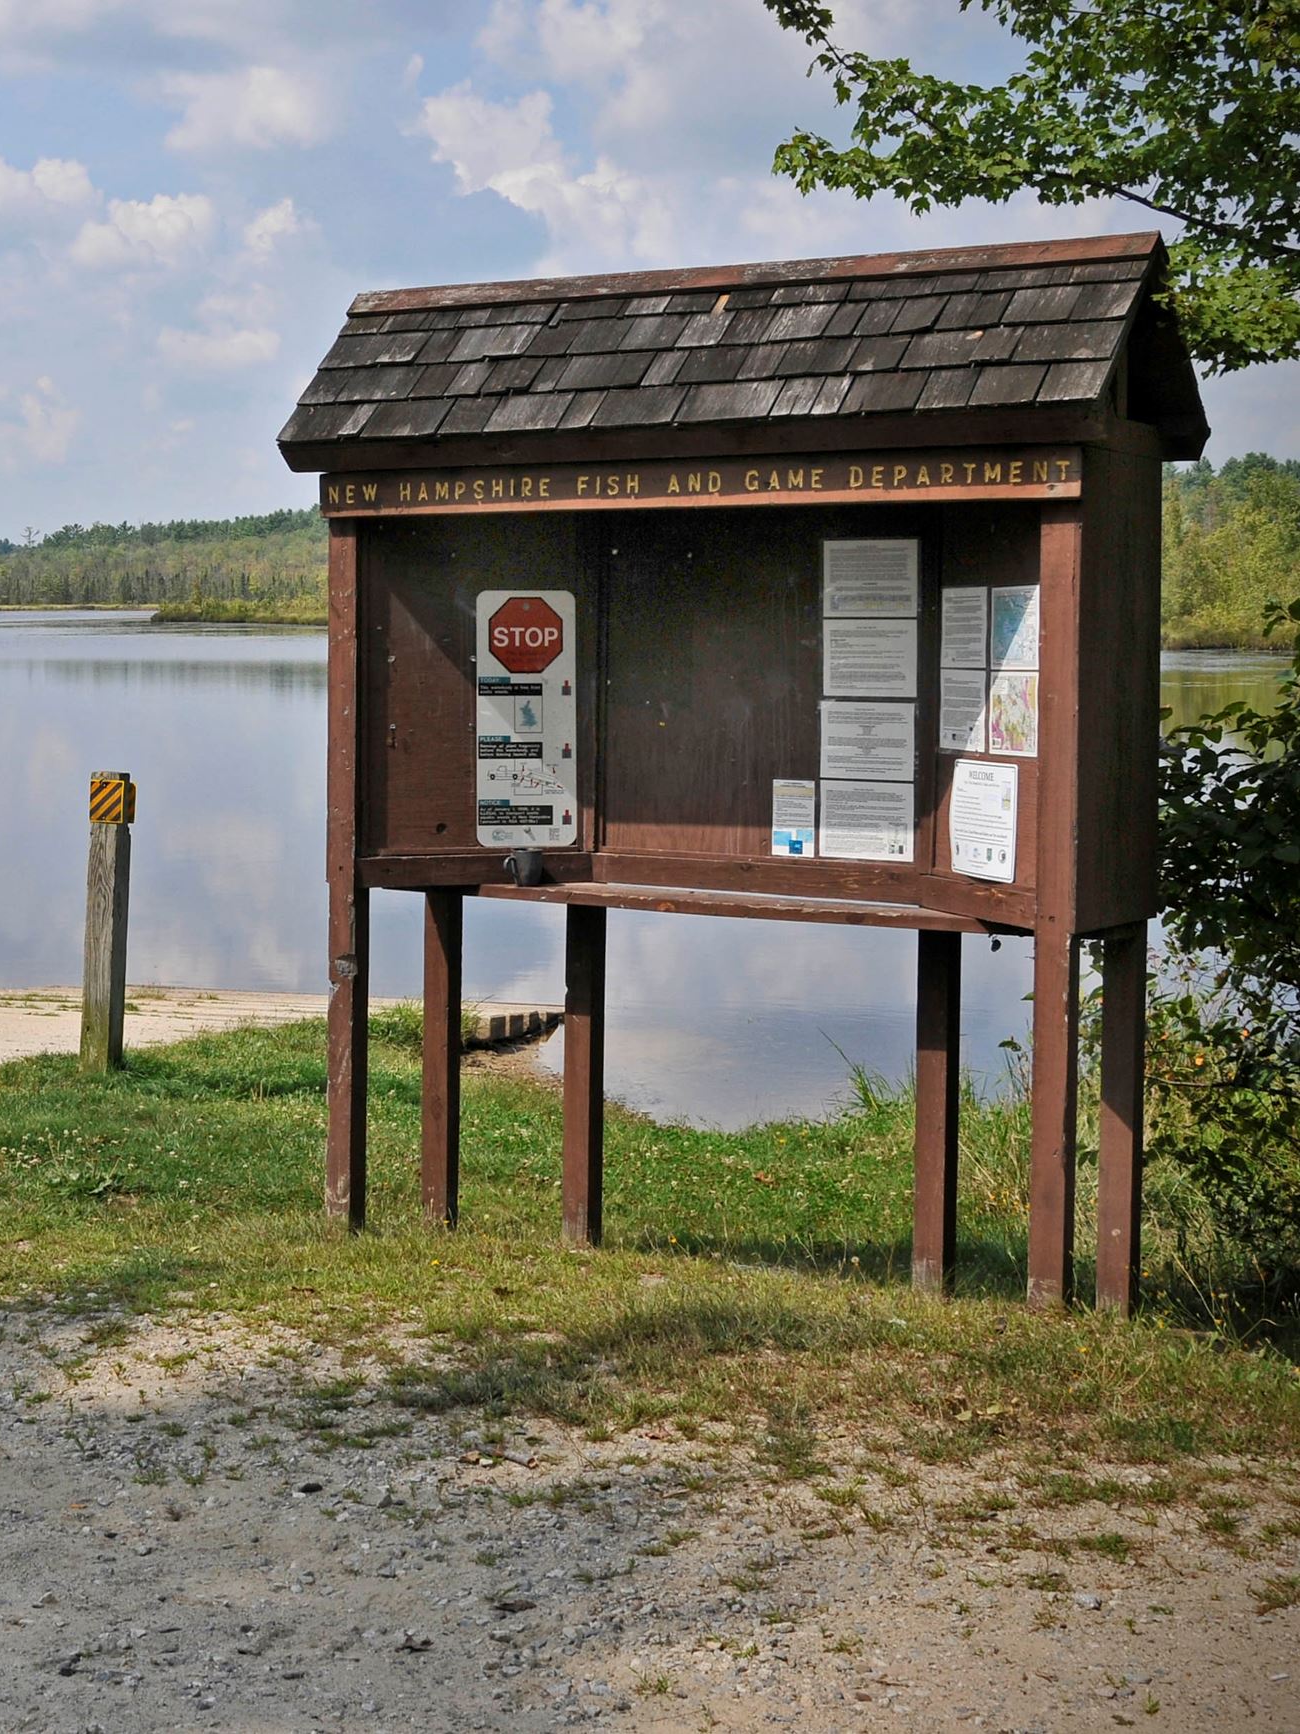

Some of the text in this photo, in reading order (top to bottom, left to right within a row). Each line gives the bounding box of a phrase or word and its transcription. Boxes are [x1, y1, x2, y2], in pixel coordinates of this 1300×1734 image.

[328, 460, 1071, 505] NEW HAMPSHIRE FISH AND GAME DEPARTMENT
[493, 626, 559, 648] STOP
